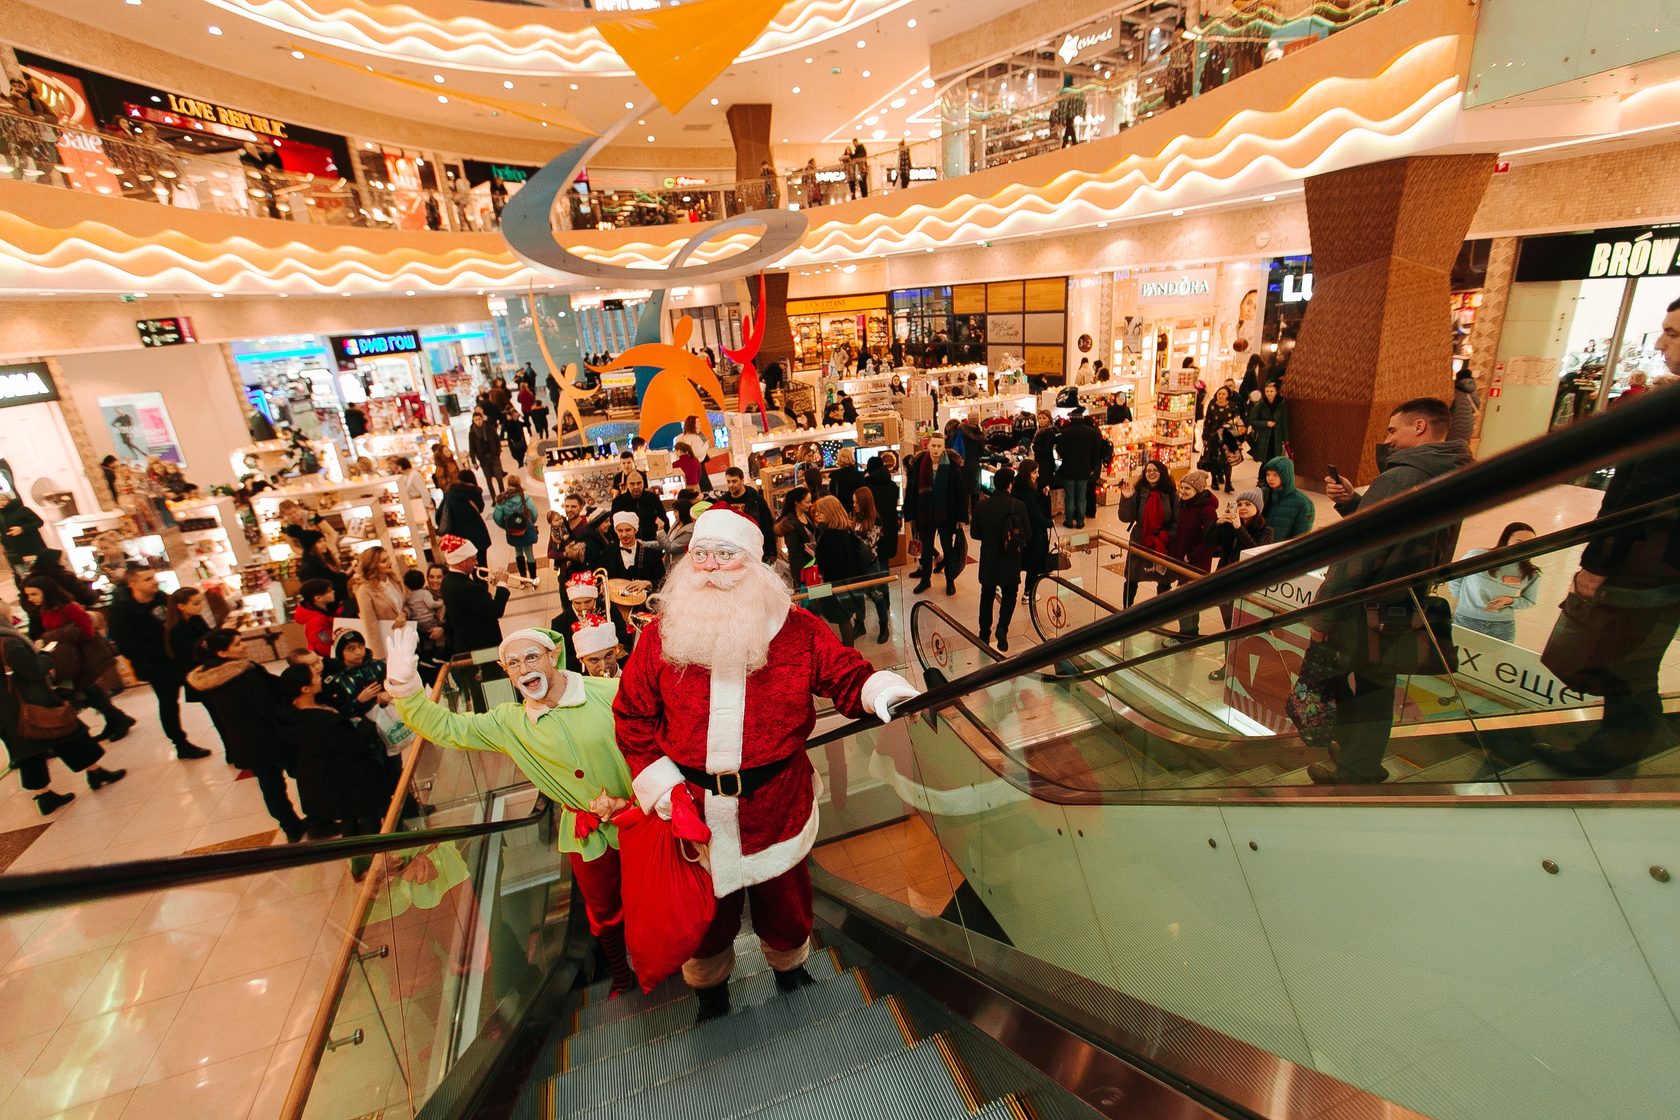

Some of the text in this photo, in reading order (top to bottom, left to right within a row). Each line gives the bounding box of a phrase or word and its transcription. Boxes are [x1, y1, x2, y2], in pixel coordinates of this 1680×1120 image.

[167, 93, 288, 139] LOVE REPUBLIC
[1141, 274, 1209, 297] PANDORA
[387, 334, 417, 352] ГОШ
